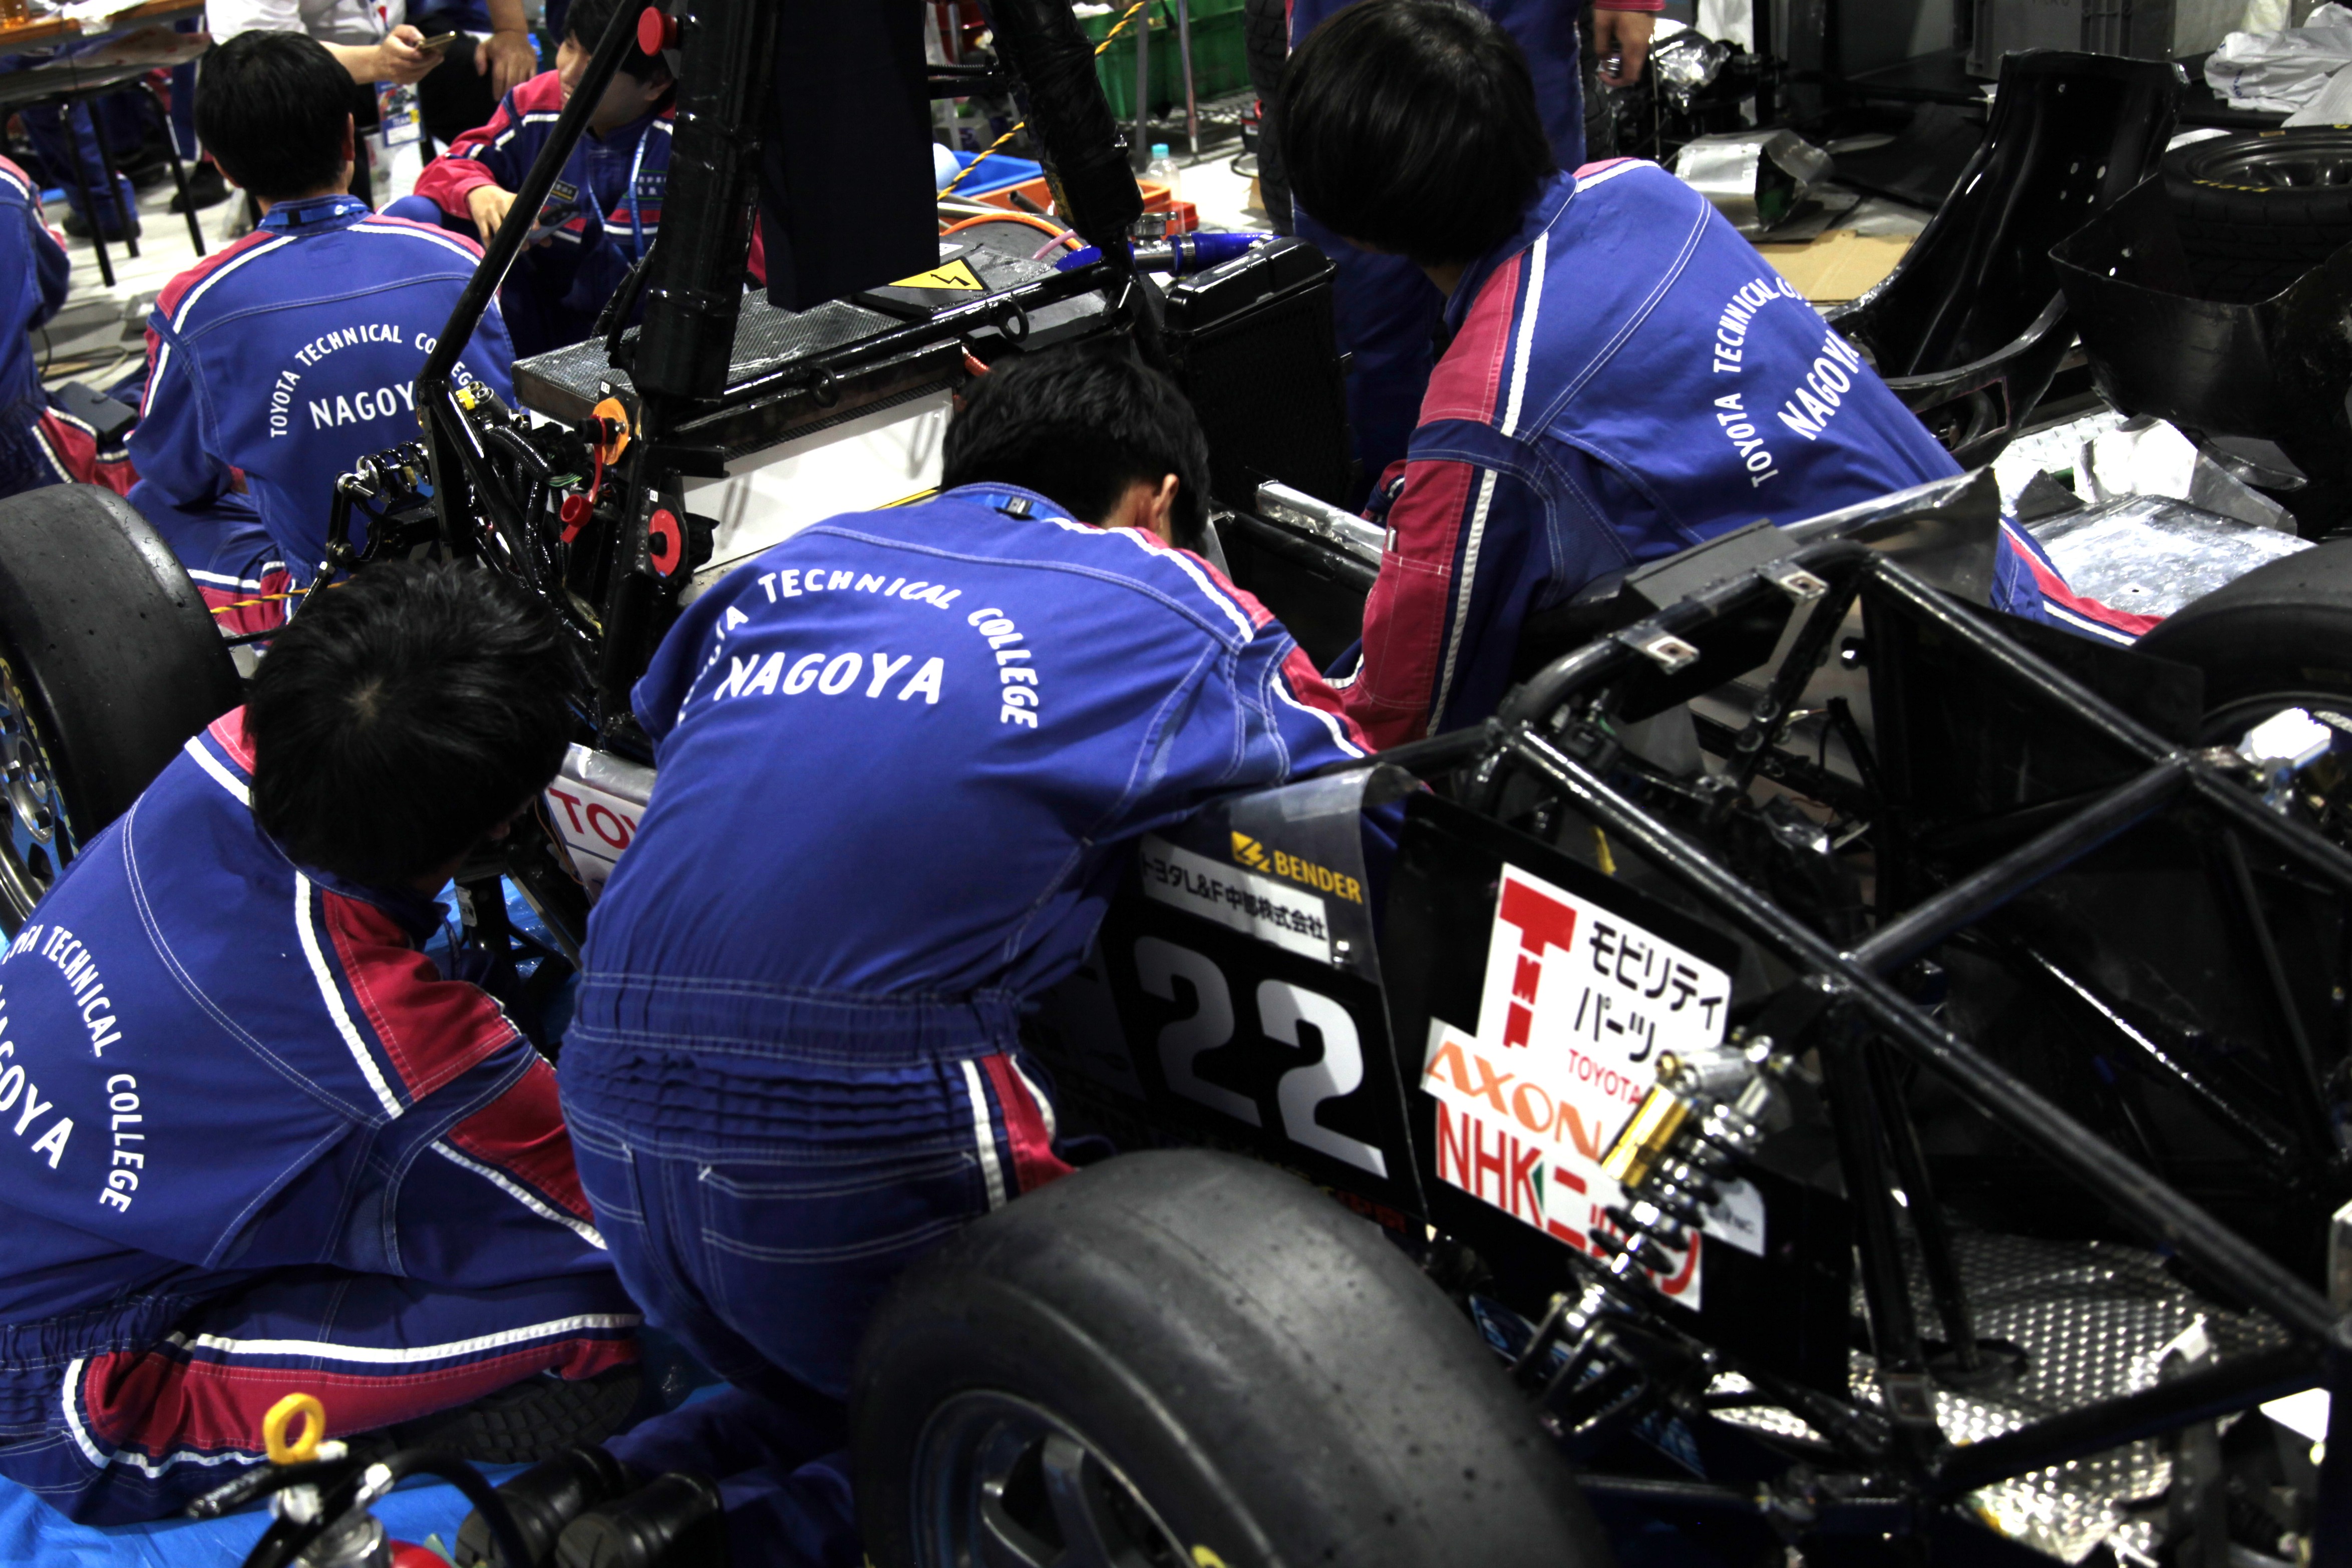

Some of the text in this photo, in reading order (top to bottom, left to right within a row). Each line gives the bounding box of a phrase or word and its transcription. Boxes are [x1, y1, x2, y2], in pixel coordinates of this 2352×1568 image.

[270, 370, 300, 438] TOYOTA
[295, 324, 402, 366] TECHNICAL
[308, 380, 415, 430] NAGOY
[1714, 278, 1780, 488] TOYOTA TECHNICAL
[714, 652, 944, 704] NAGOYA
[758, 569, 1039, 728] TECHNICAL COLLEGE
[1274, 850, 1363, 905] BENDER
[1574, 987, 1655, 1063] パーツ
[1589, 921, 1723, 1031] モビリティ
[42, 926, 122, 1058] TECHNICAL
[100, 1074, 145, 1213] COLLEGE
[1133, 935, 1389, 1181] 22
[1424, 1041, 1602, 1161] AXON
[1569, 1049, 1642, 1105] TOYOTA
